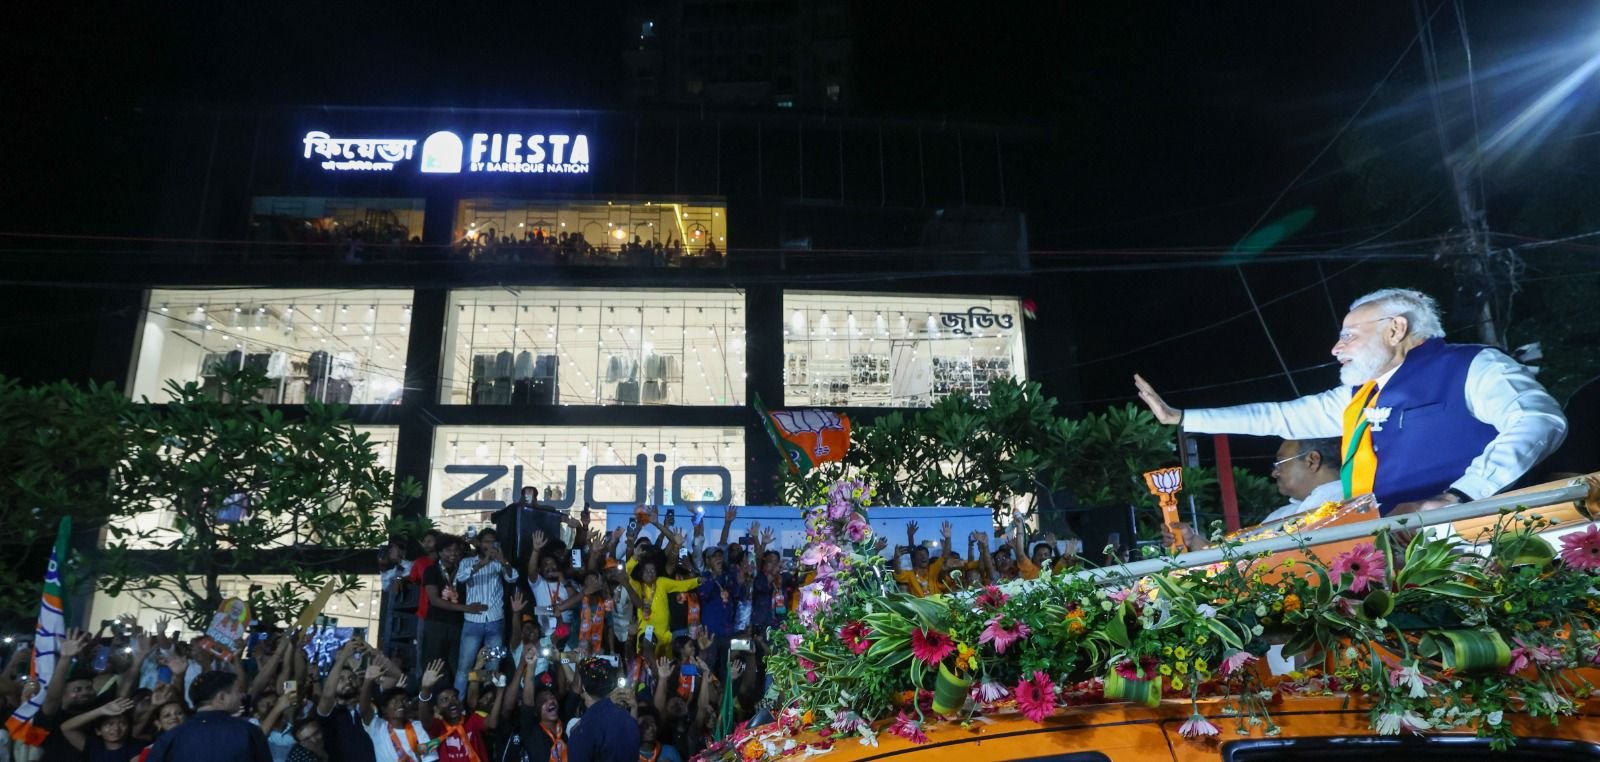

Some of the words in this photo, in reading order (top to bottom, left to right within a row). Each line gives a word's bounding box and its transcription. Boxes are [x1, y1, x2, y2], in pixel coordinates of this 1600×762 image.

[470, 133, 590, 164] FIESTA
[470, 163, 485, 172] BY
[486, 163, 545, 173] BARBEQUE
[546, 163, 589, 173] NATION
[939, 306, 1014, 335] জুডিও
[441, 453, 732, 510] zudio
